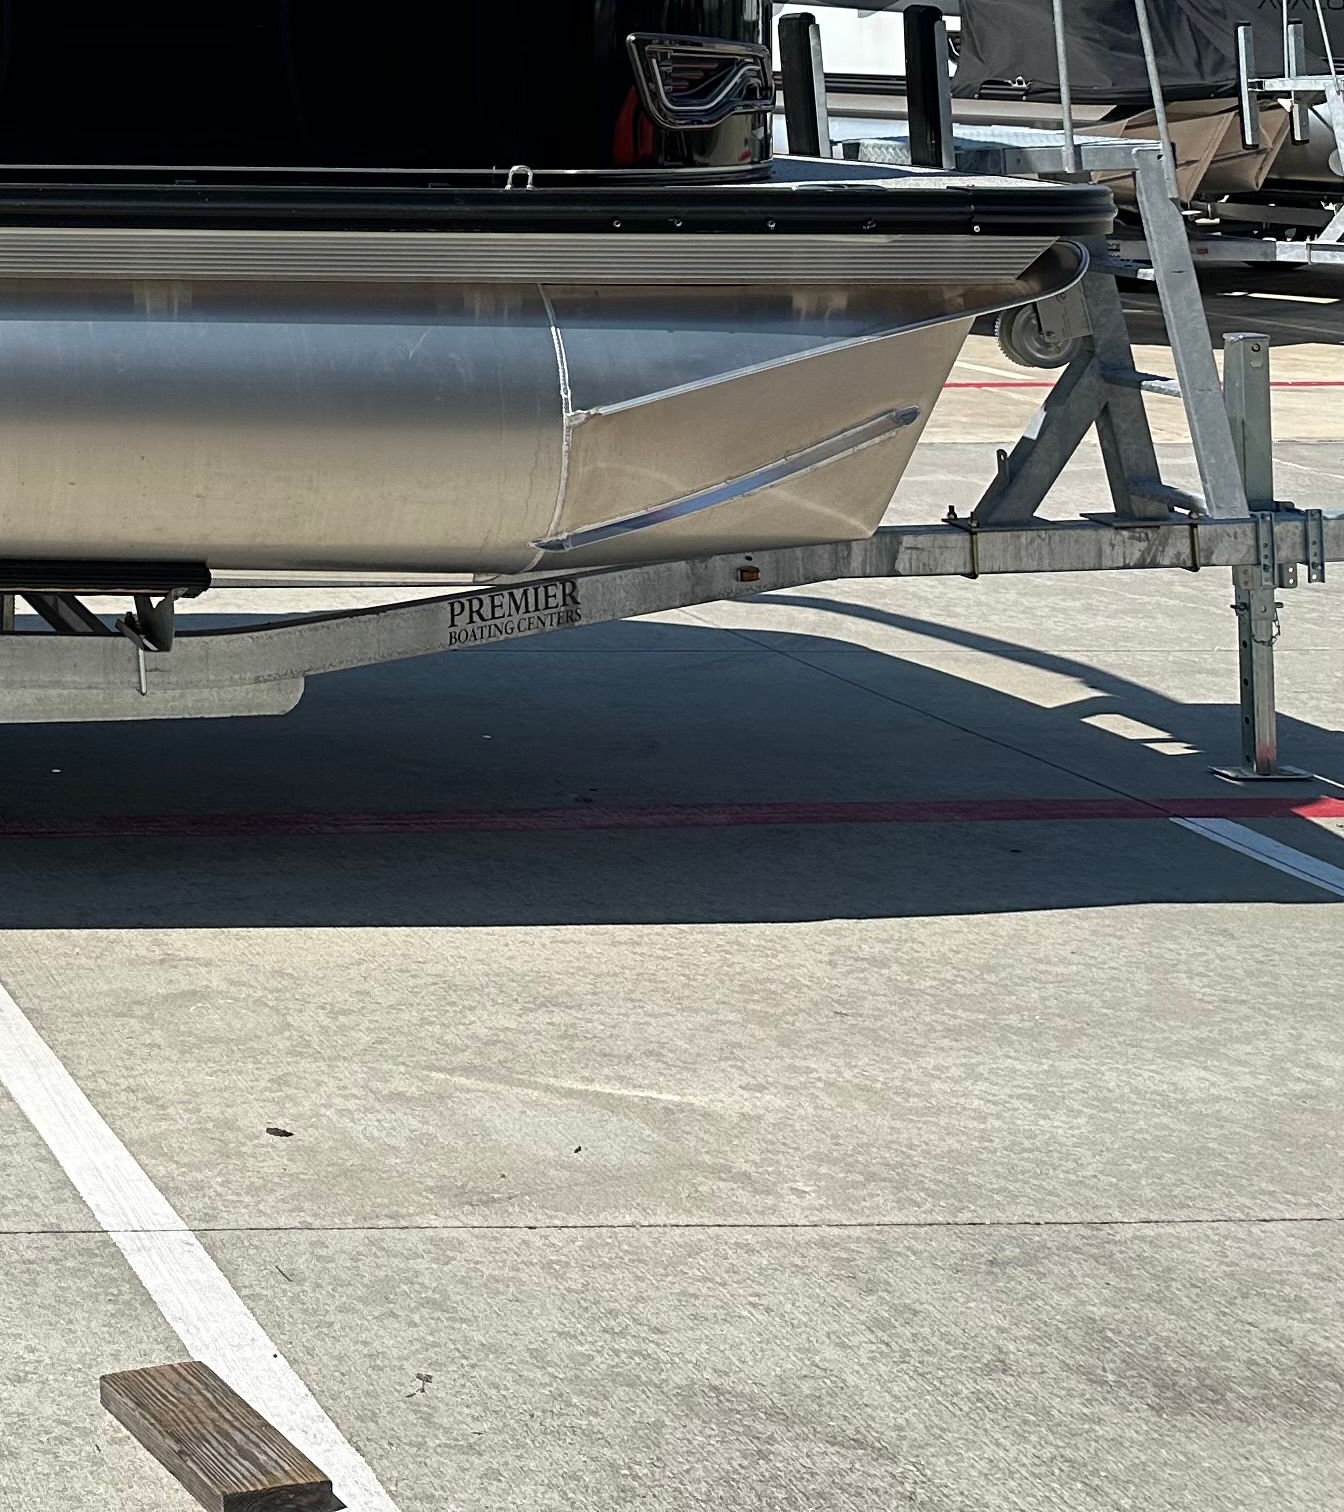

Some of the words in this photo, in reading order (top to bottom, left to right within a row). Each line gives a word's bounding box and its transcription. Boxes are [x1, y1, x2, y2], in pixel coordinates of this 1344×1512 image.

[447, 579, 581, 629] PREMIER
[448, 621, 515, 647] BOATING
[517, 607, 582, 633] CENTERS
